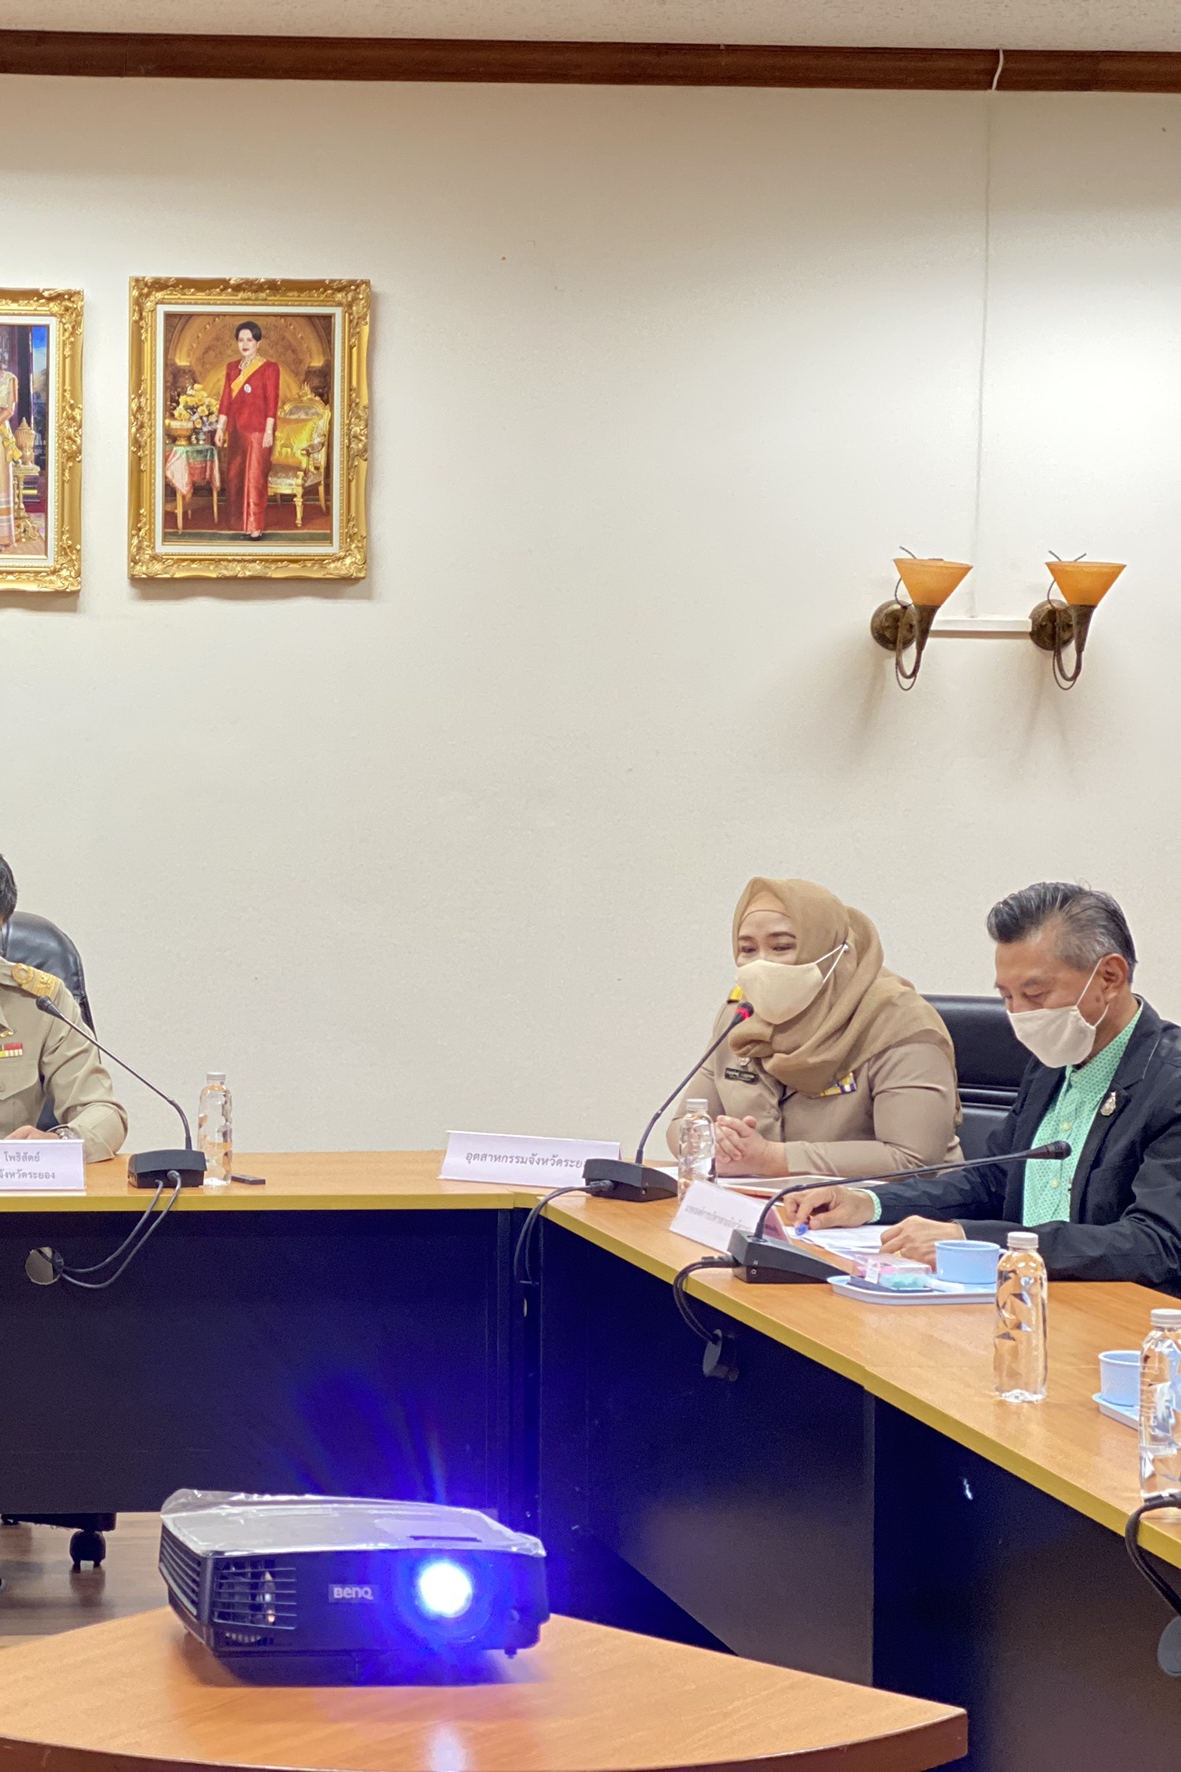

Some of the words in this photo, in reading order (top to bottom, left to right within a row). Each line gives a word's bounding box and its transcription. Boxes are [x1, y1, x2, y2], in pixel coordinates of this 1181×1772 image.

[465, 1151, 586, 1169] อุตสาหกรรมจังหวัดระย
[333, 1586, 374, 1601] BenQ
